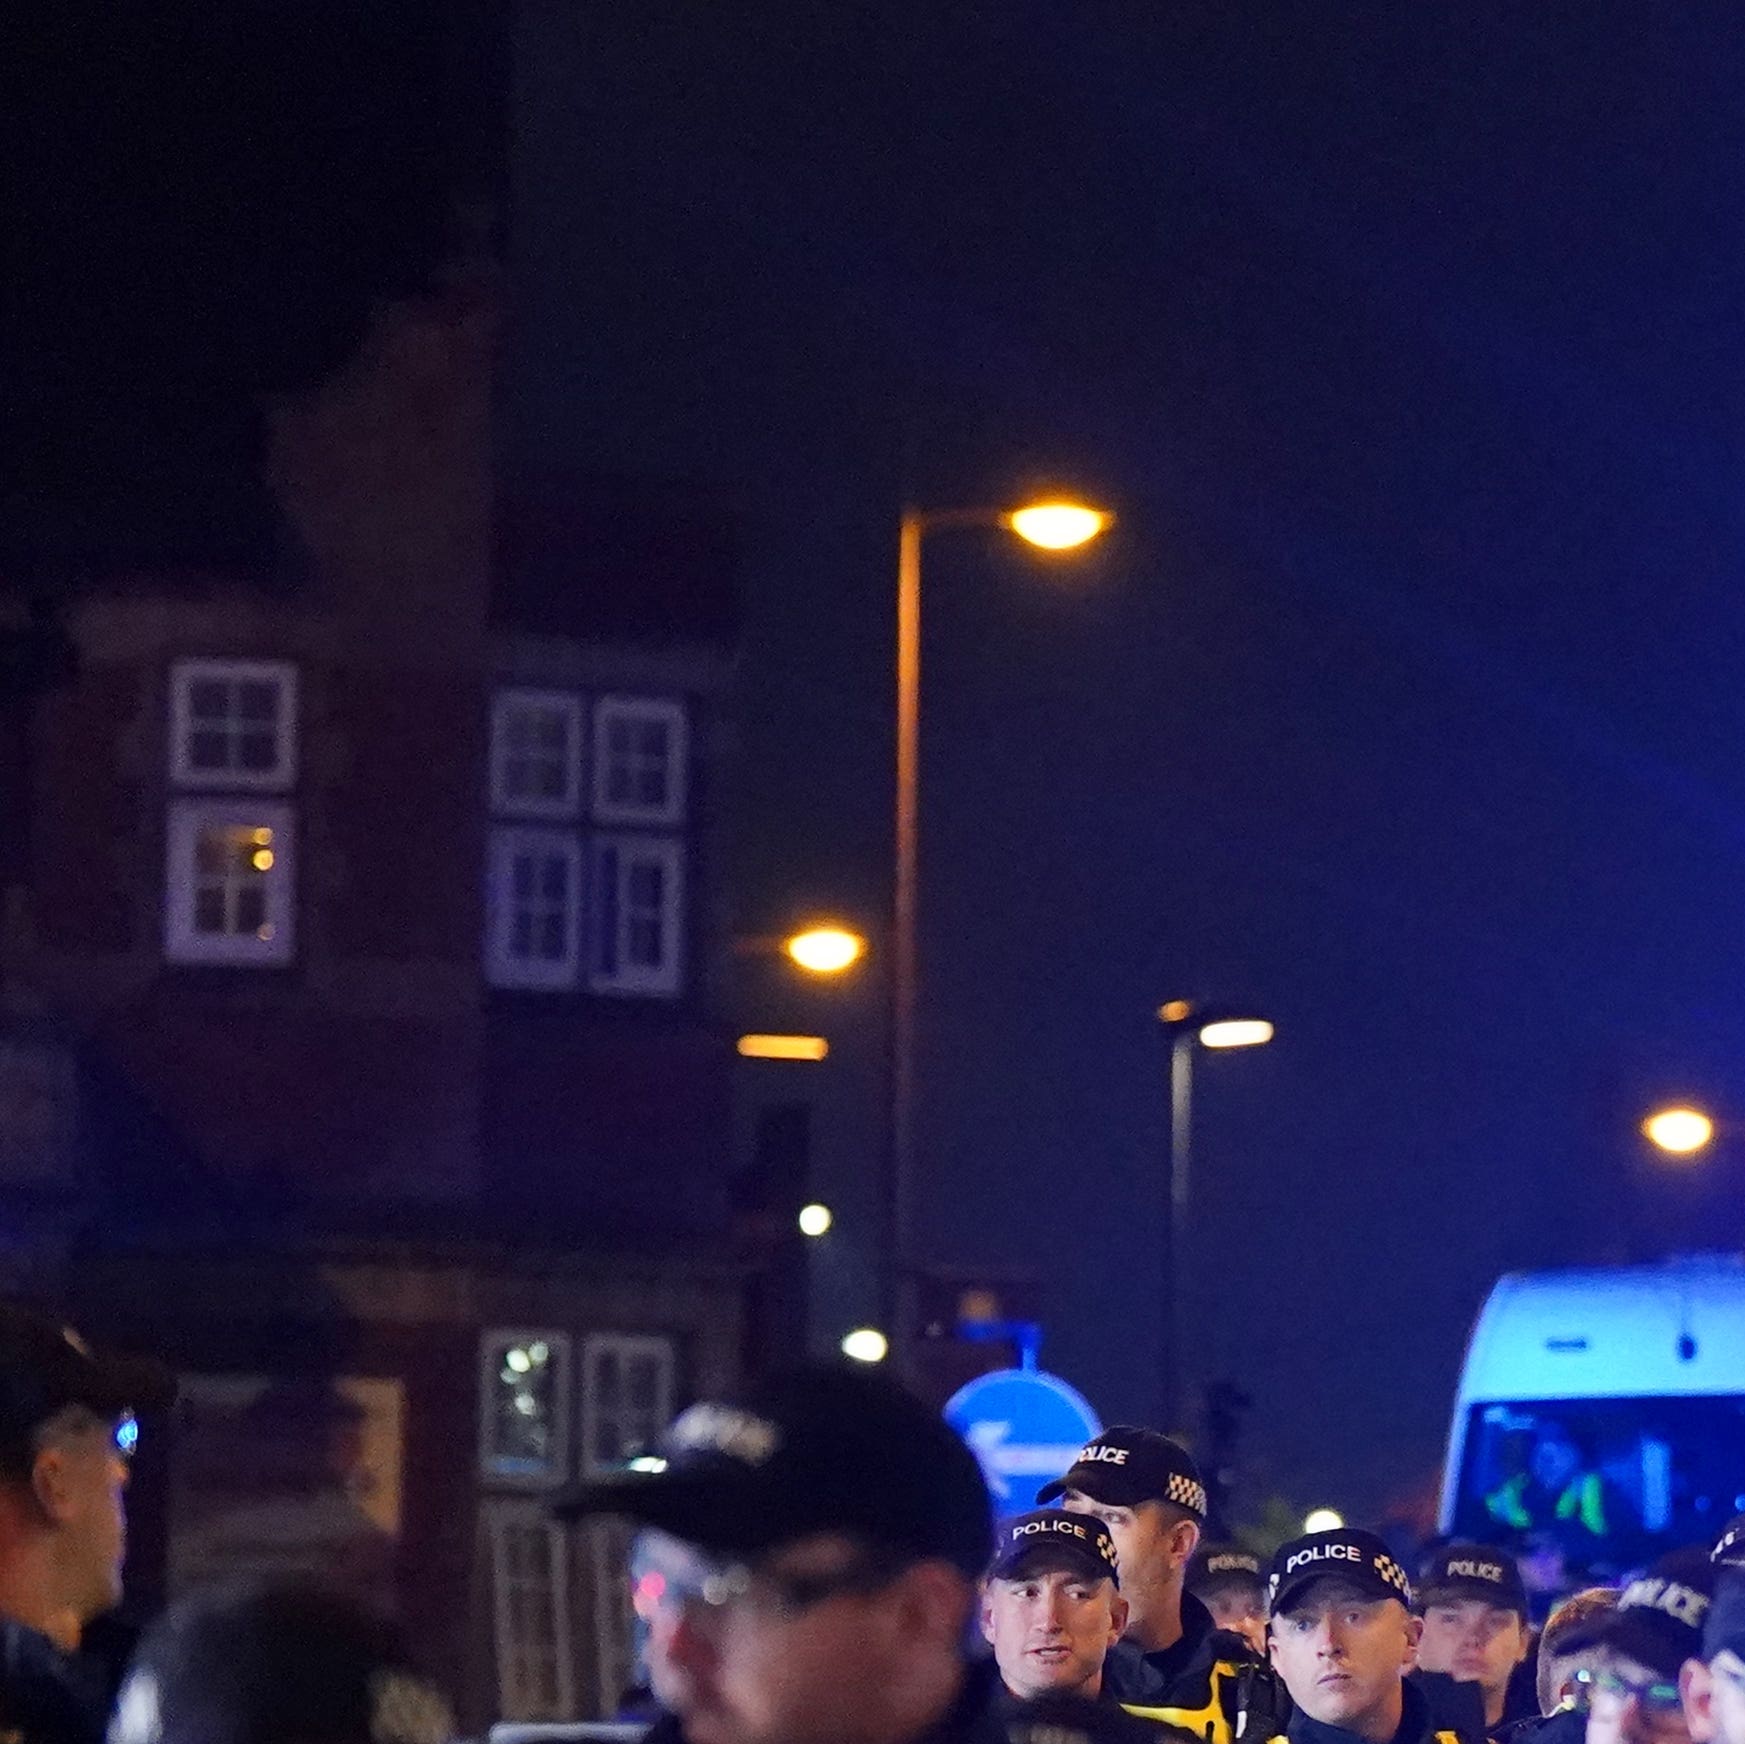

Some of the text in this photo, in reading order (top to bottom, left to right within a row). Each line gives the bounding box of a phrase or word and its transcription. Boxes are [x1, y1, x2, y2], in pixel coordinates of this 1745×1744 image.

[1012, 1520, 1088, 1541] POLICE
[1286, 1544, 1363, 1575] POLICE
[1447, 1559, 1504, 1584] POLICE
